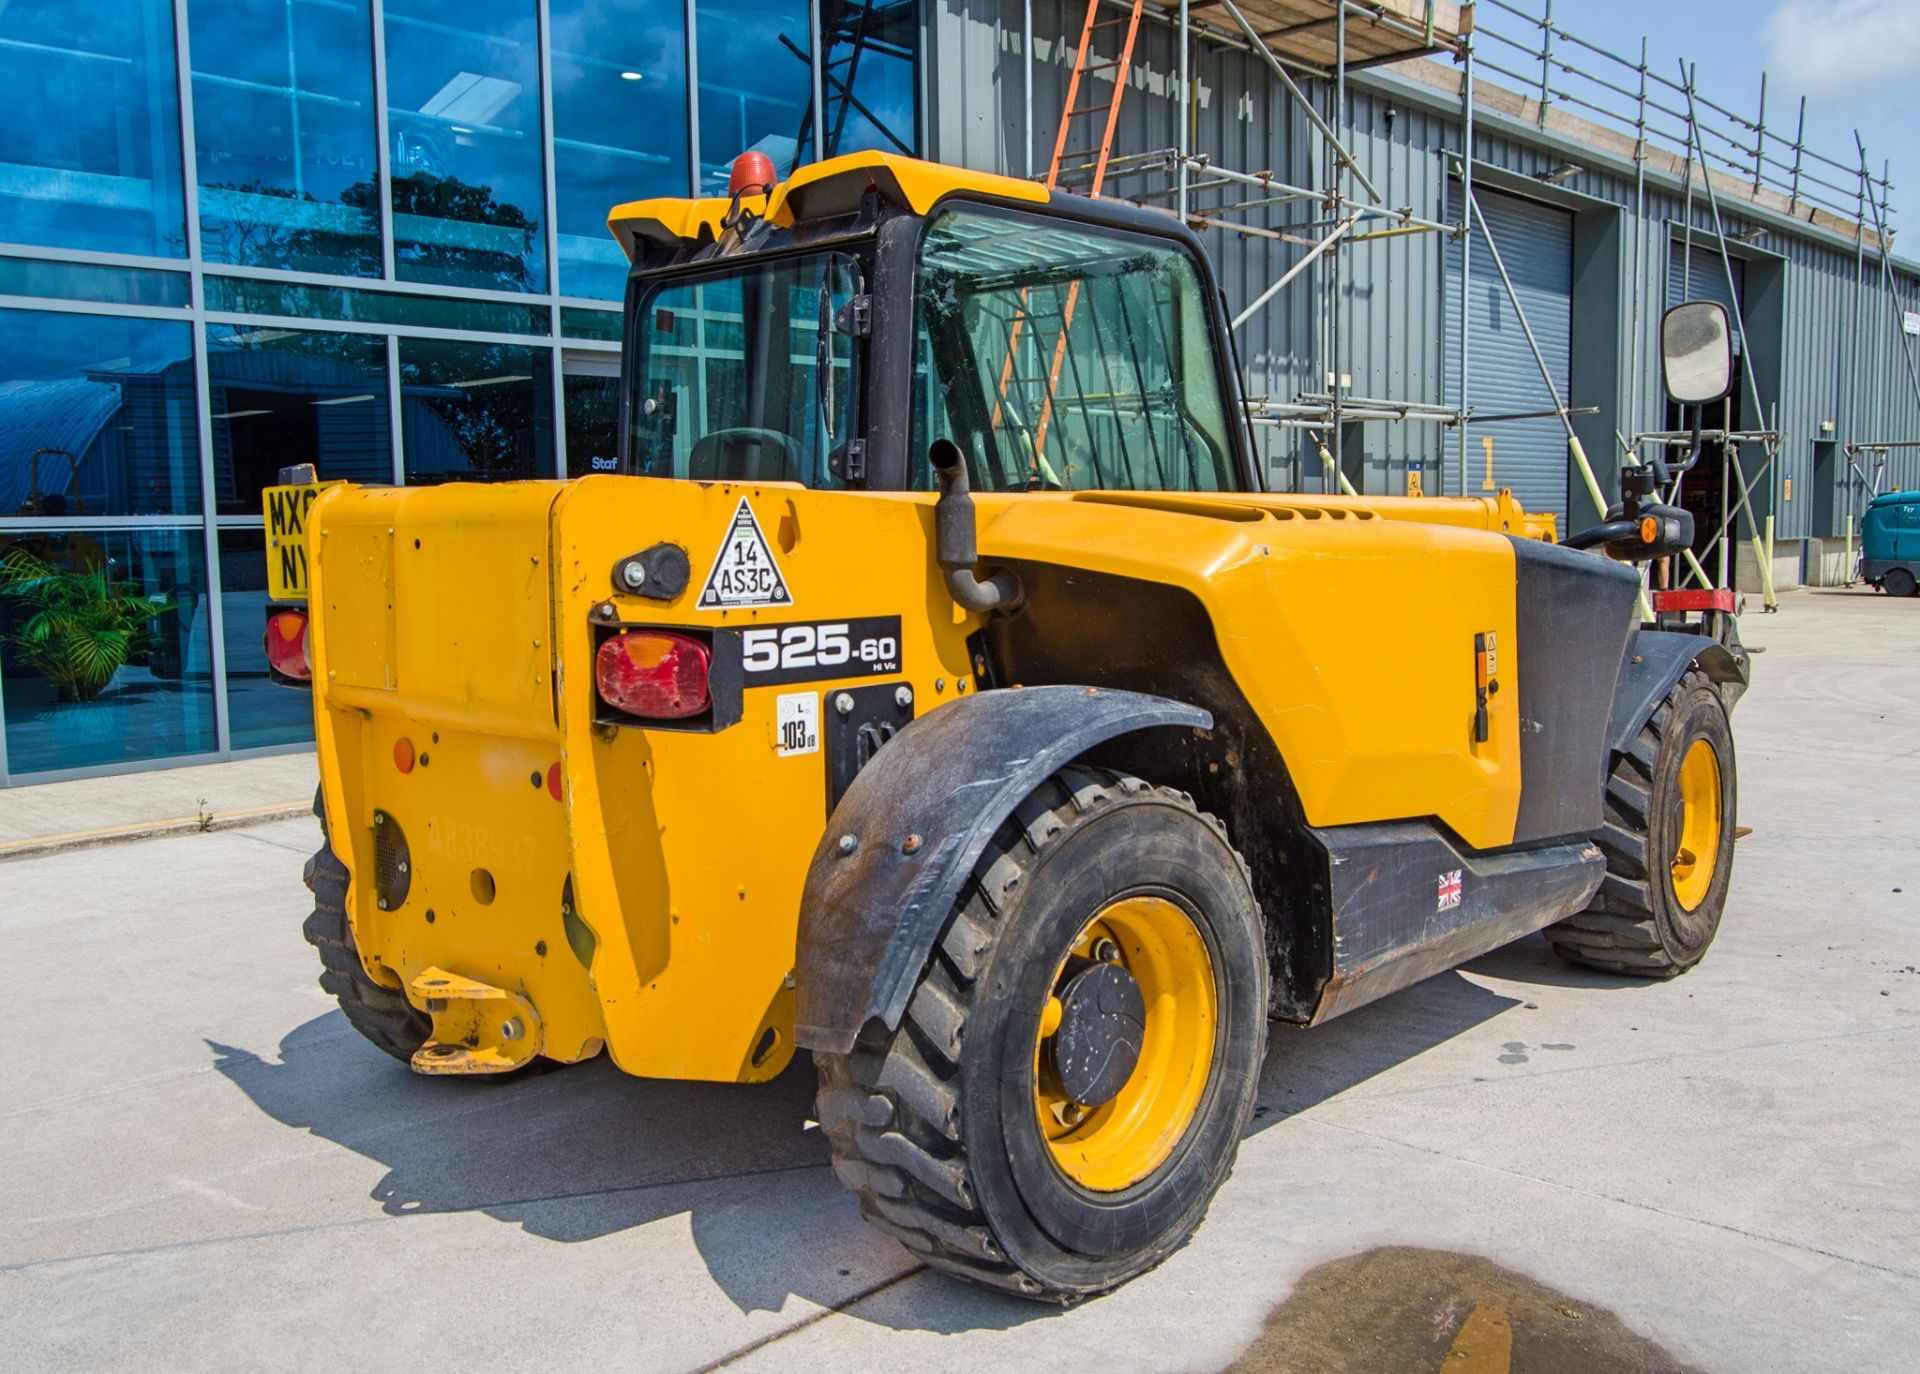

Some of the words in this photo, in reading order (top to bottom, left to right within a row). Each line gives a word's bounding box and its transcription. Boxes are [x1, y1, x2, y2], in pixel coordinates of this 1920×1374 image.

[592, 456, 618, 470] Staf
[1482, 436, 1496, 490] 1
[269, 487, 322, 535] MX
[734, 540, 757, 566] 14
[721, 567, 771, 594] AS3C
[782, 720, 806, 750] 103
